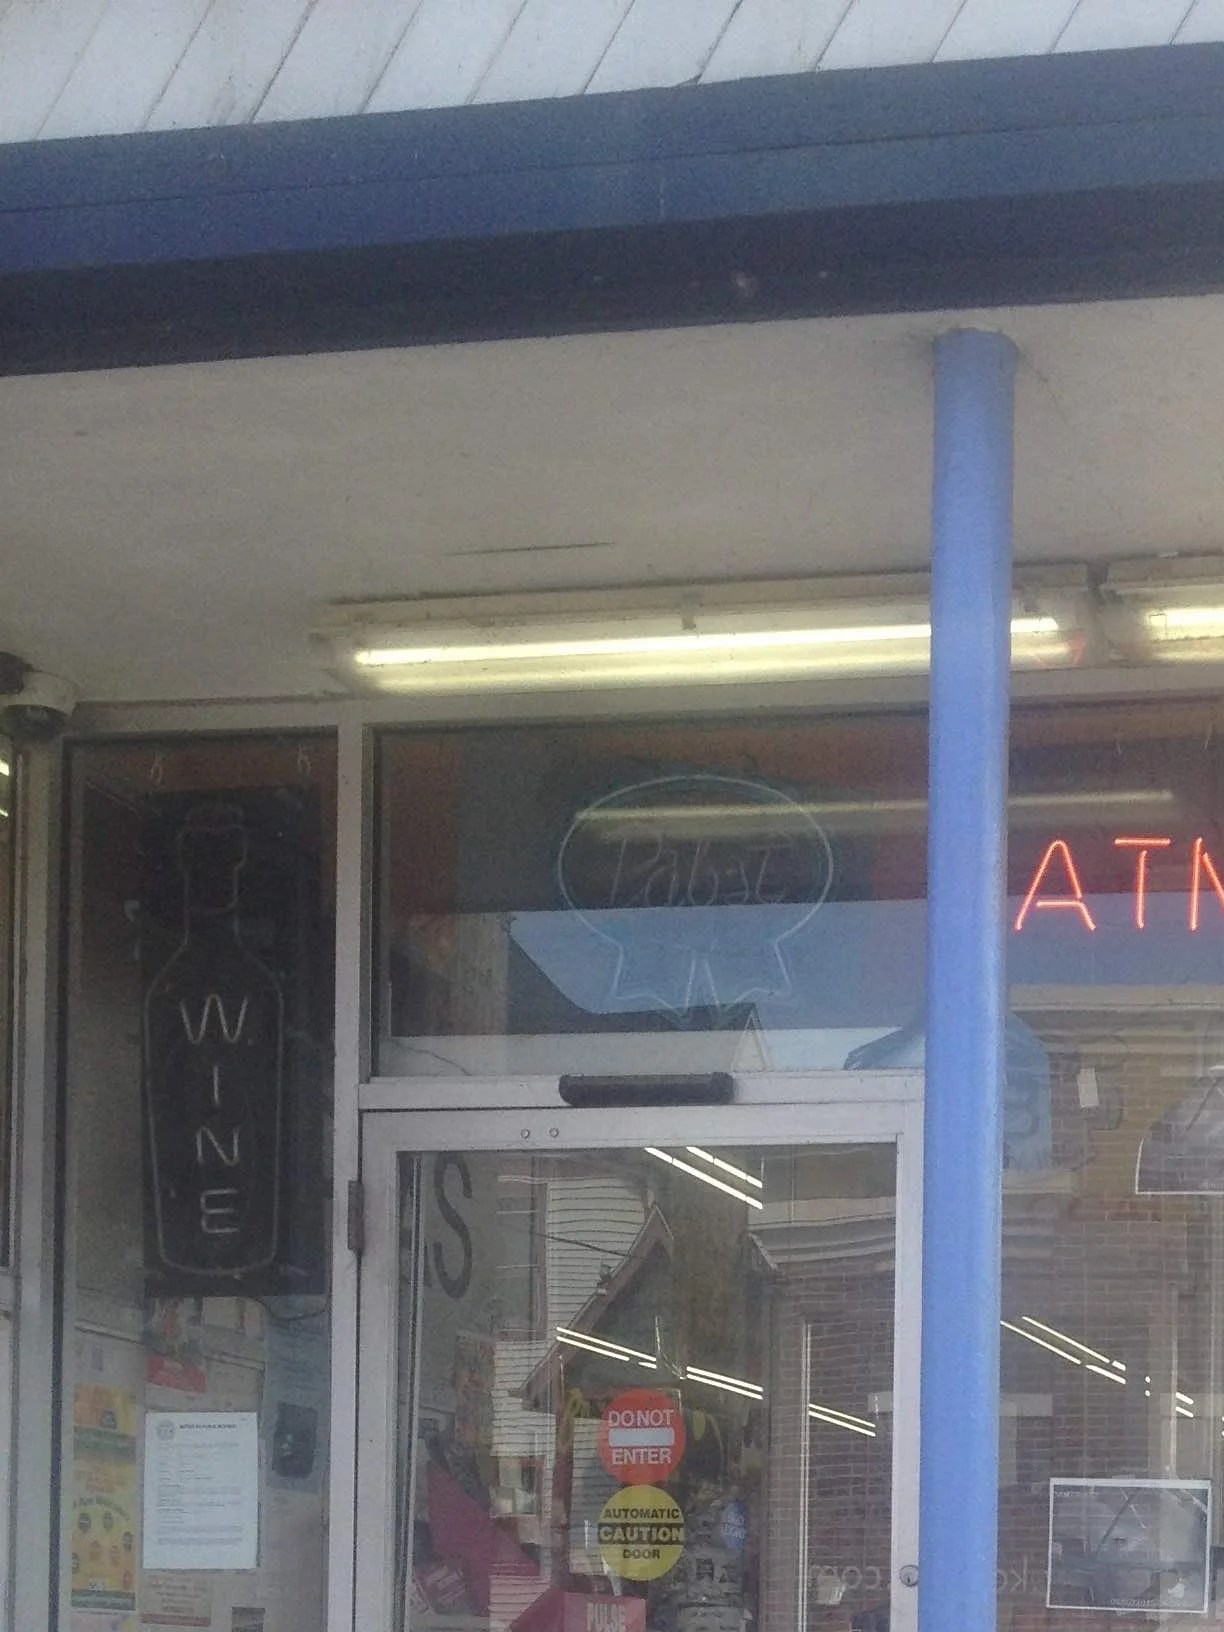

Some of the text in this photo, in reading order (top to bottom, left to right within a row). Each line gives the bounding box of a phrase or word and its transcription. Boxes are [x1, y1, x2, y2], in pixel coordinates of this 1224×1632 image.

[178, 994, 248, 1236] WINE
[608, 1409, 674, 1427] DO NOT
[612, 1448, 672, 1465] ENTER
[604, 1508, 680, 1520] AUTOMATIC
[599, 1526, 684, 1542] CAUTION
[623, 1549, 661, 1559] DOOR
